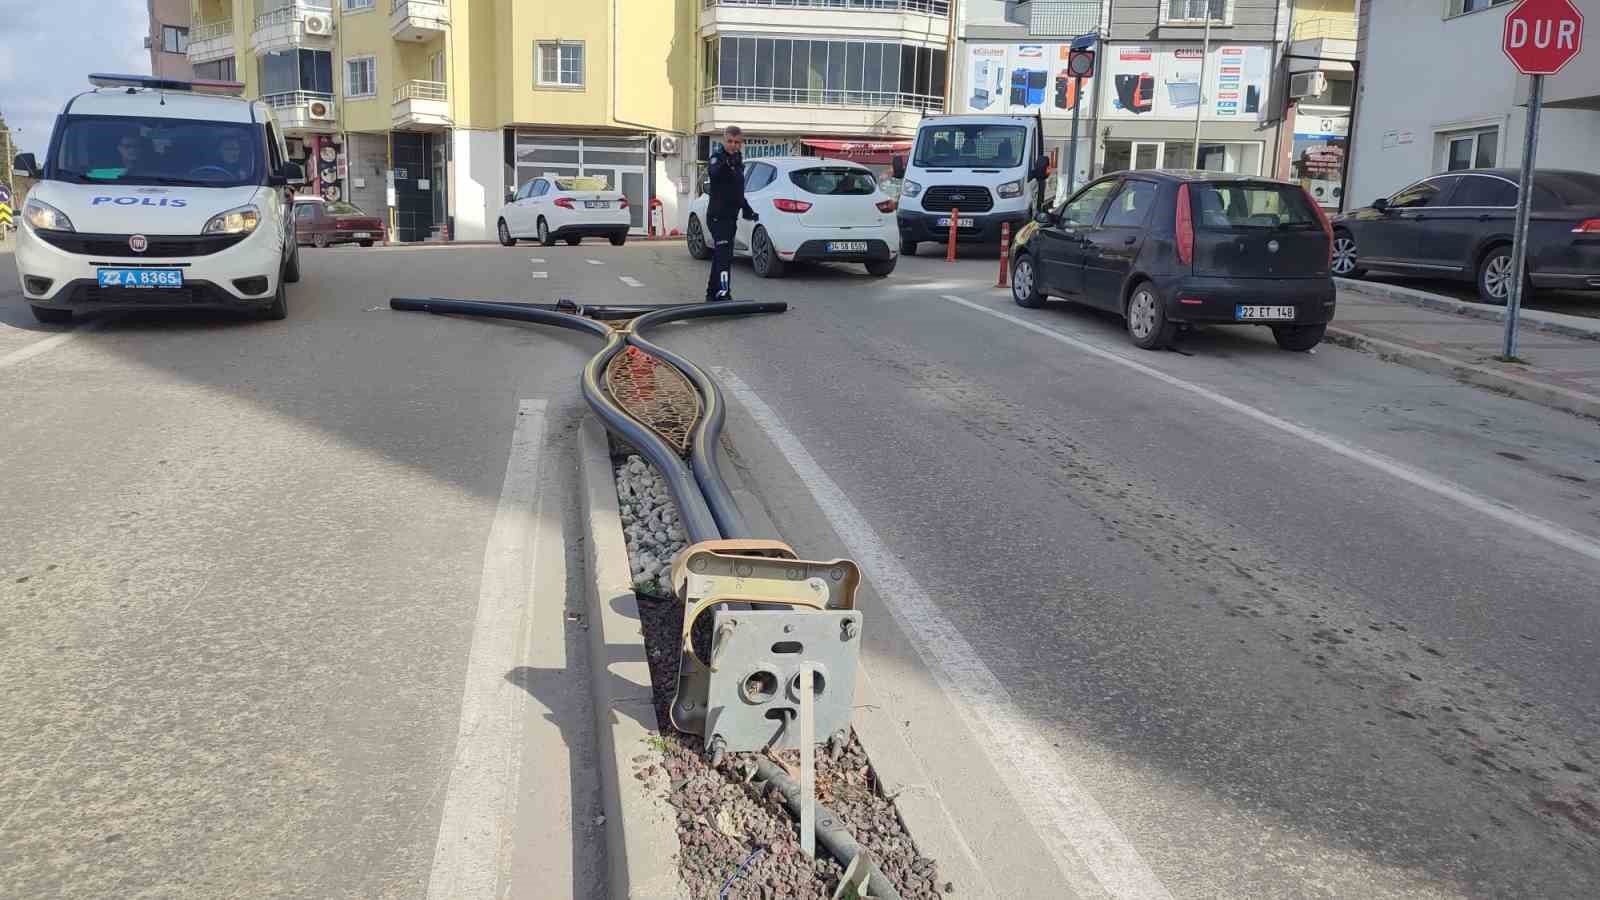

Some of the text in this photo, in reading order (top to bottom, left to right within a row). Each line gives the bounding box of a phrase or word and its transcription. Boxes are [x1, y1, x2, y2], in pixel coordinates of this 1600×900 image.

[1510, 18, 1576, 49] DUR
[126, 272, 137, 284] A
[141, 272, 176, 284] 8365
[1243, 307, 1255, 318] 22
[1260, 307, 1270, 318] ET
